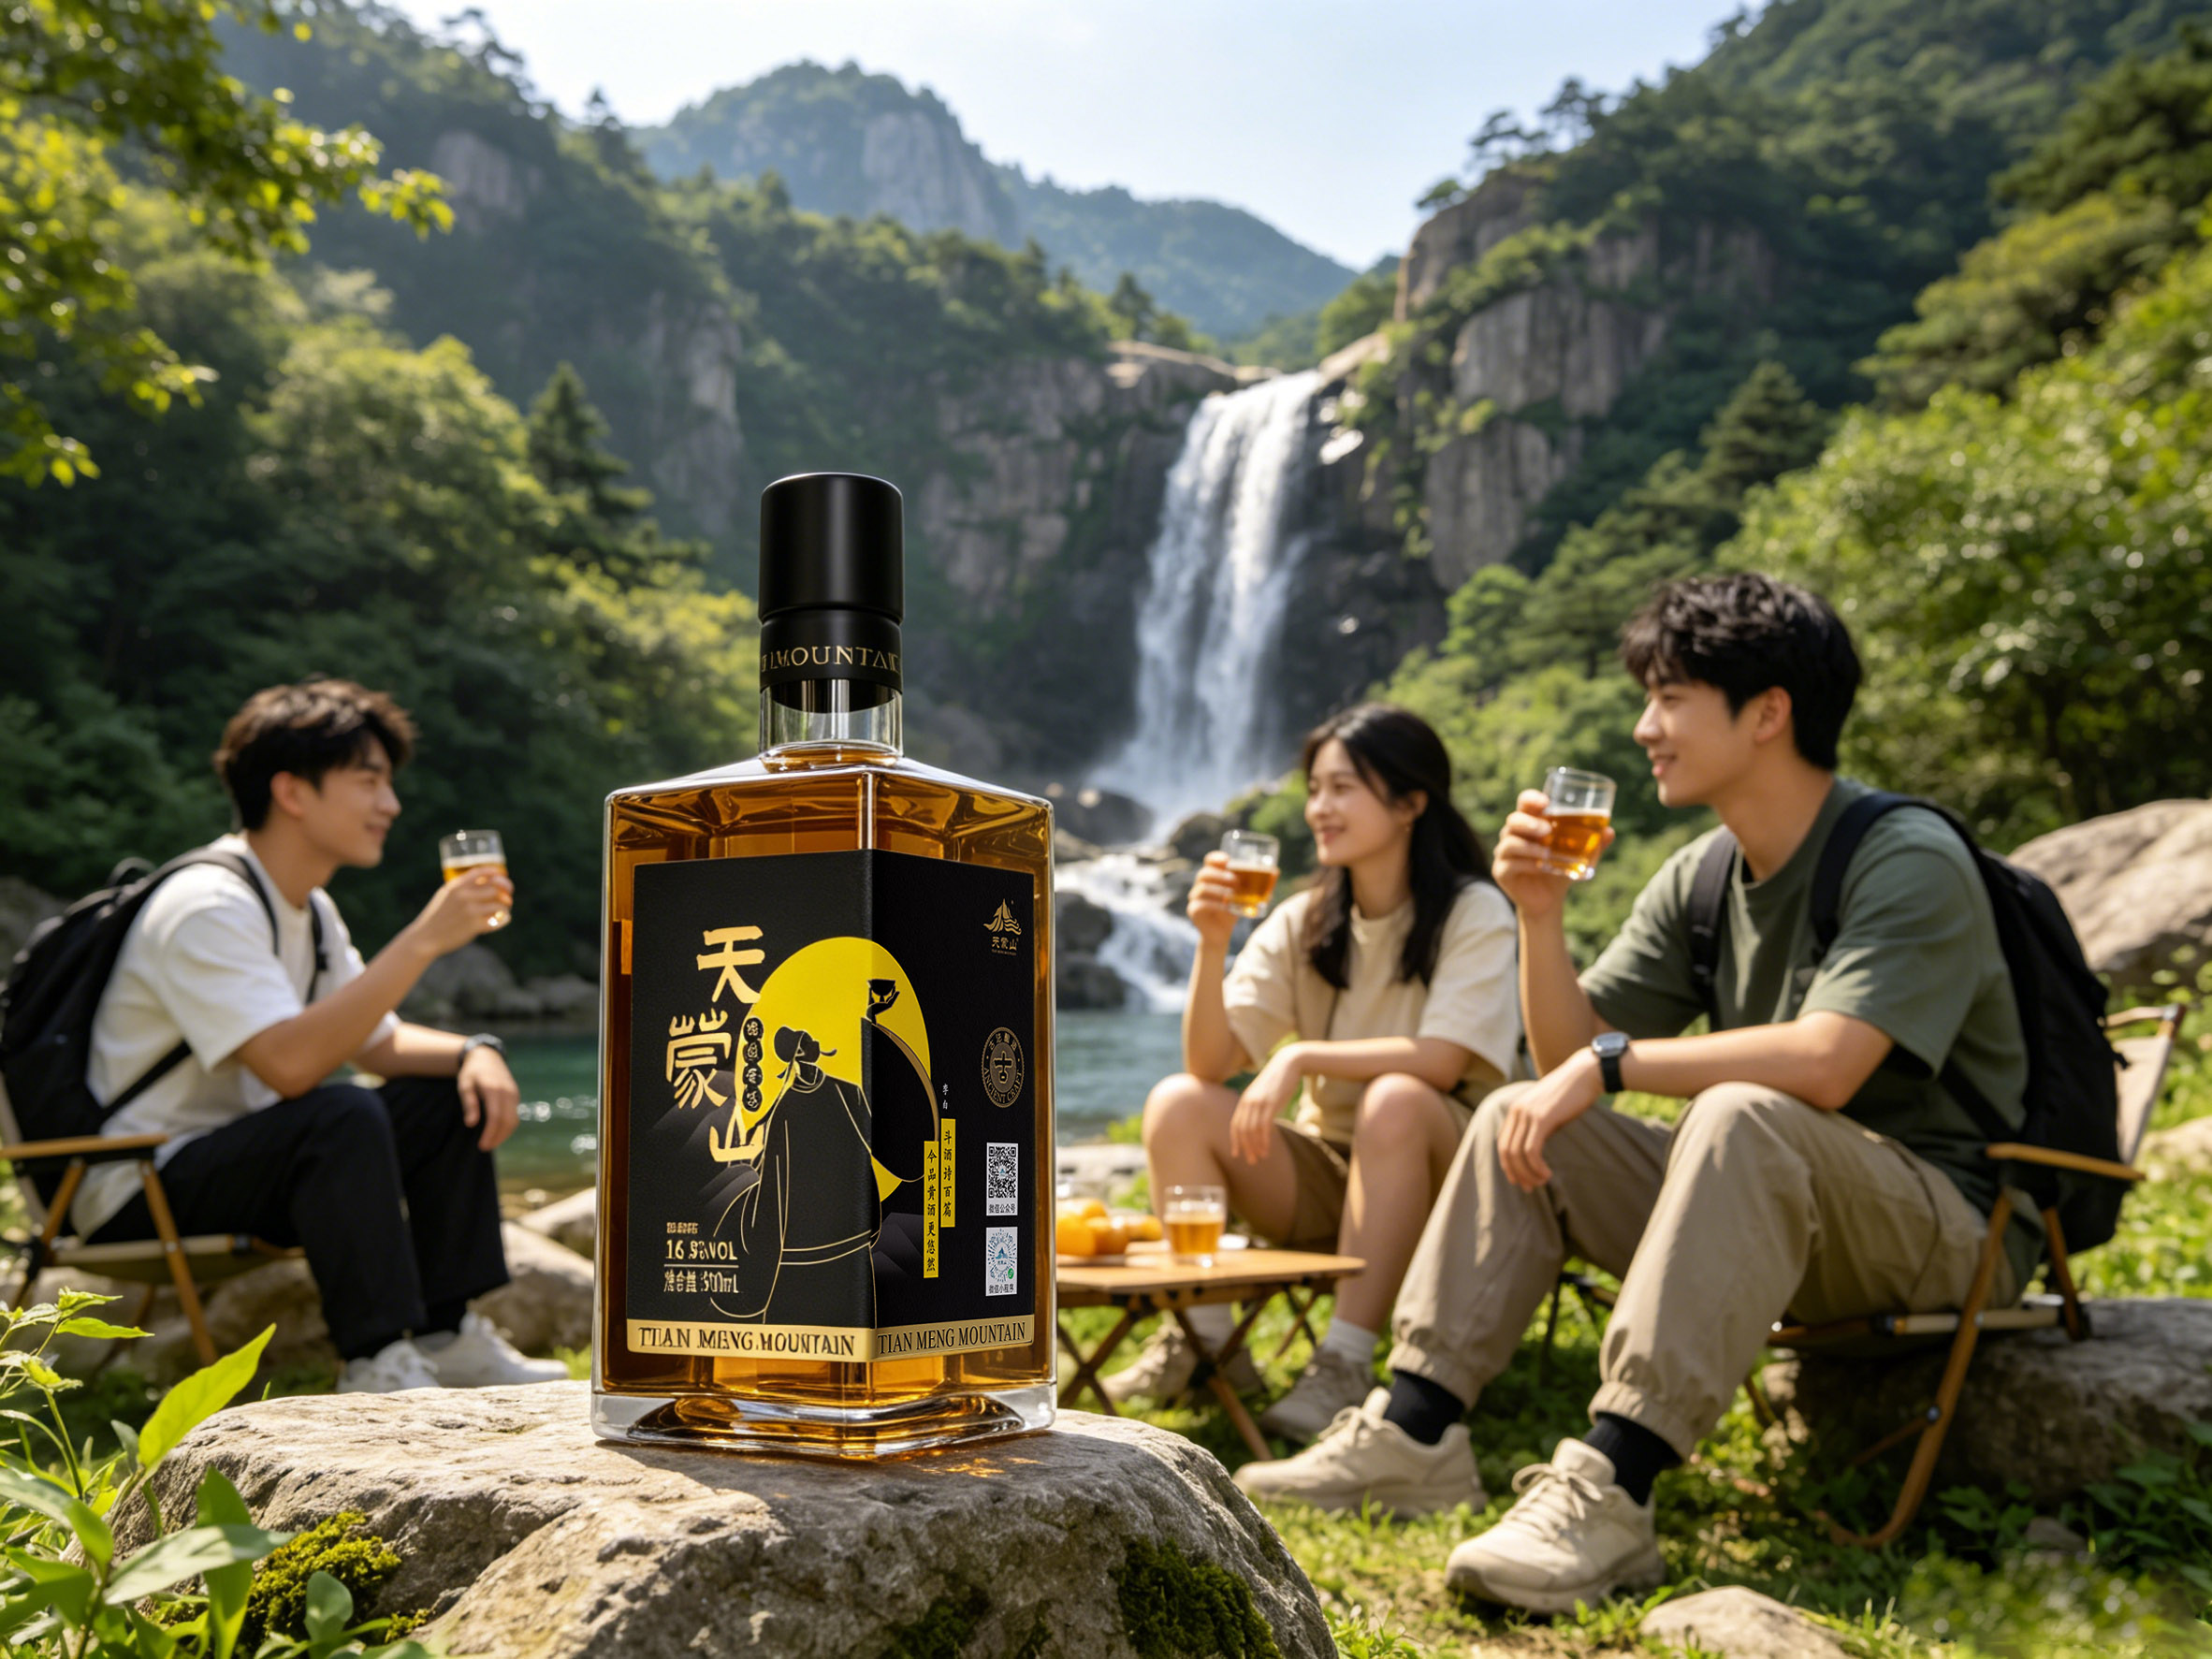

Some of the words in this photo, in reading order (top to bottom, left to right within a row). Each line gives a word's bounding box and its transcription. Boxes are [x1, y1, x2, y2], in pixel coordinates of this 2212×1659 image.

[665, 925, 765, 1162] 天蒙山
[878, 1332, 912, 1354] TIAN
[916, 1328, 954, 1350] MENG
[958, 1321, 1026, 1346] MOUNTAIN
